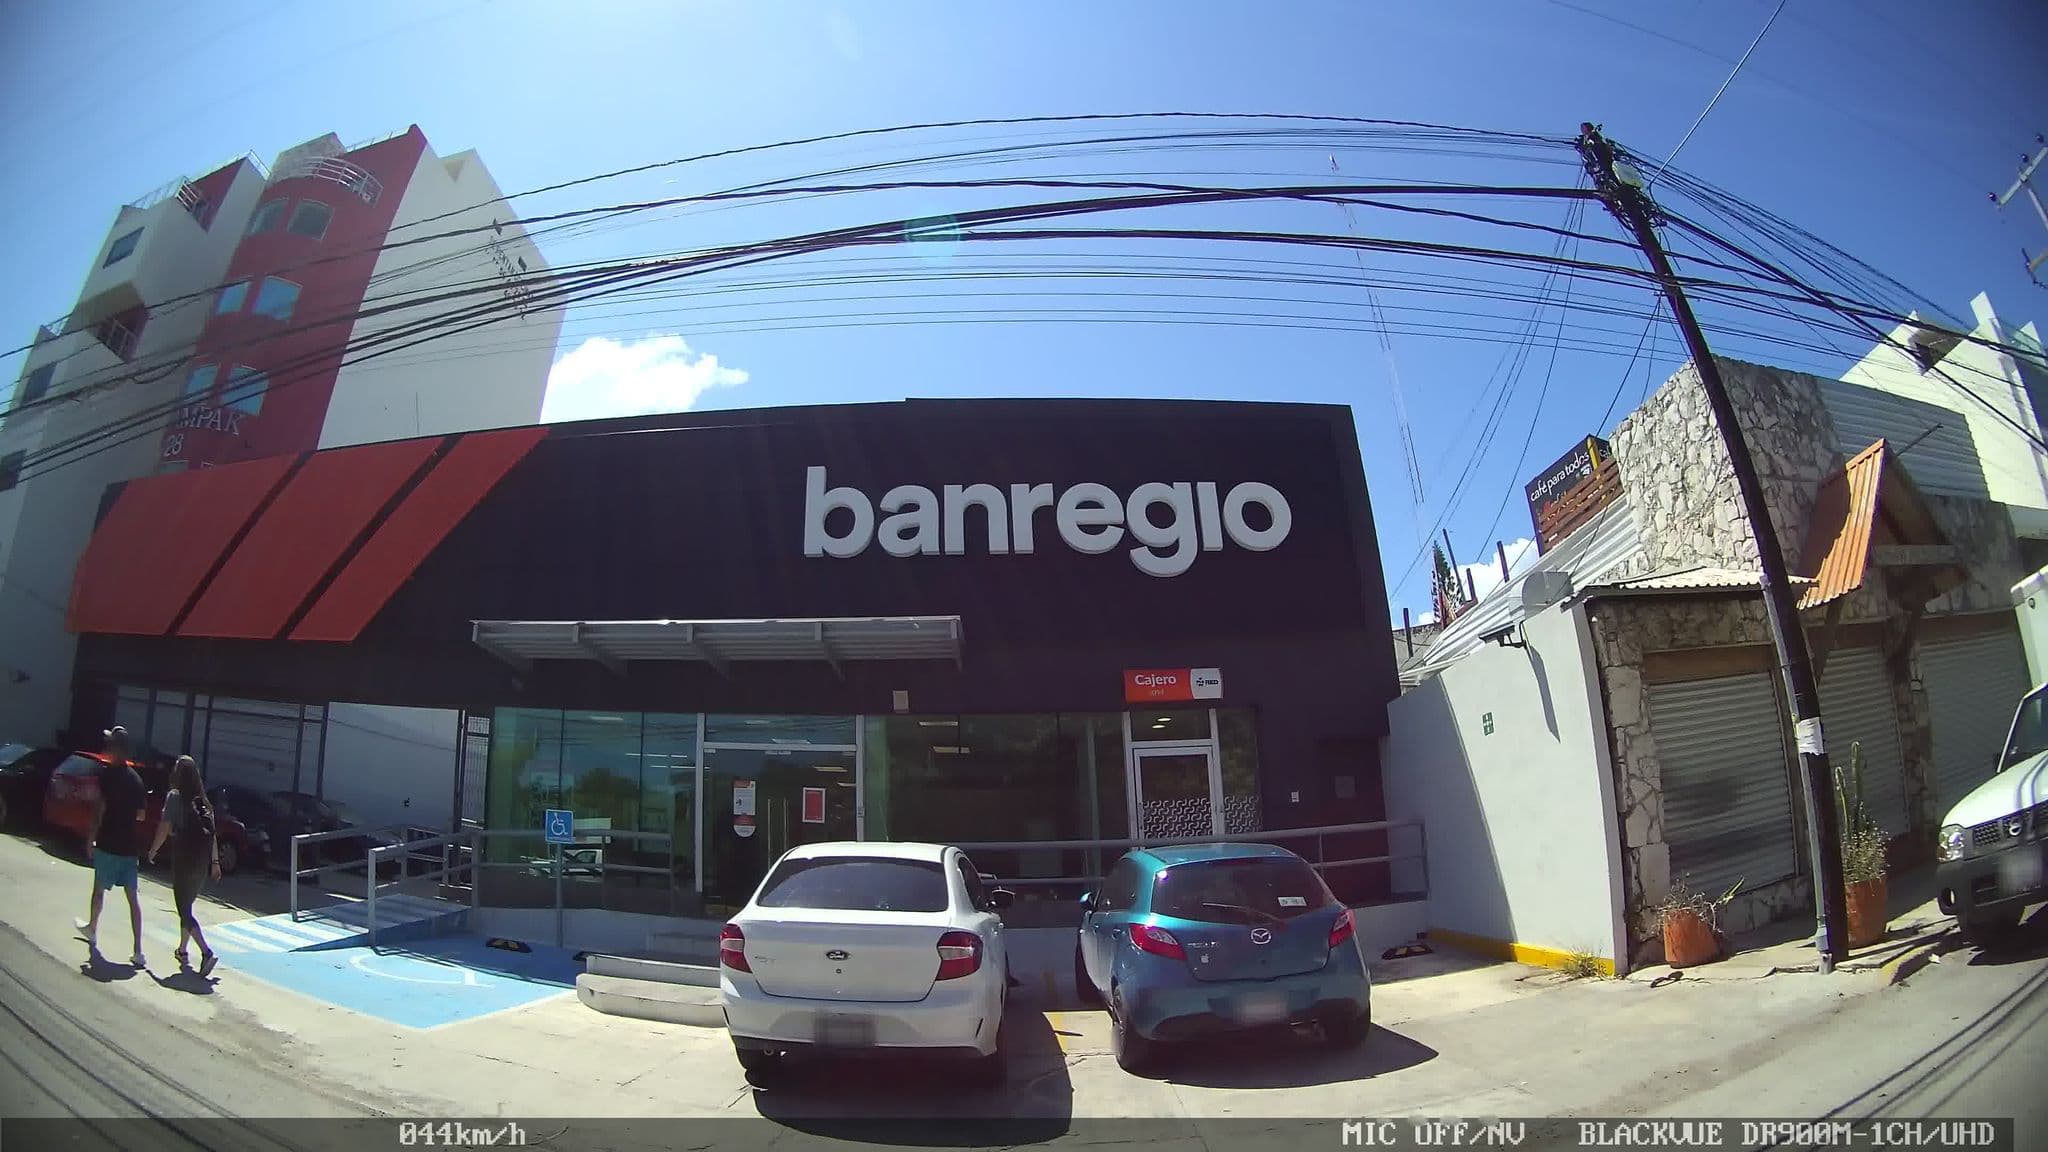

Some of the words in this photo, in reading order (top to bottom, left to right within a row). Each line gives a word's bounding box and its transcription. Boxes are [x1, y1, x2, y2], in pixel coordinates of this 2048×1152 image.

[1530, 479, 1549, 502] café
[1547, 471, 1567, 496] para
[1564, 452, 1590, 477] todos
[804, 466, 1293, 578] banregio
[1134, 674, 1177, 687] Cajero
